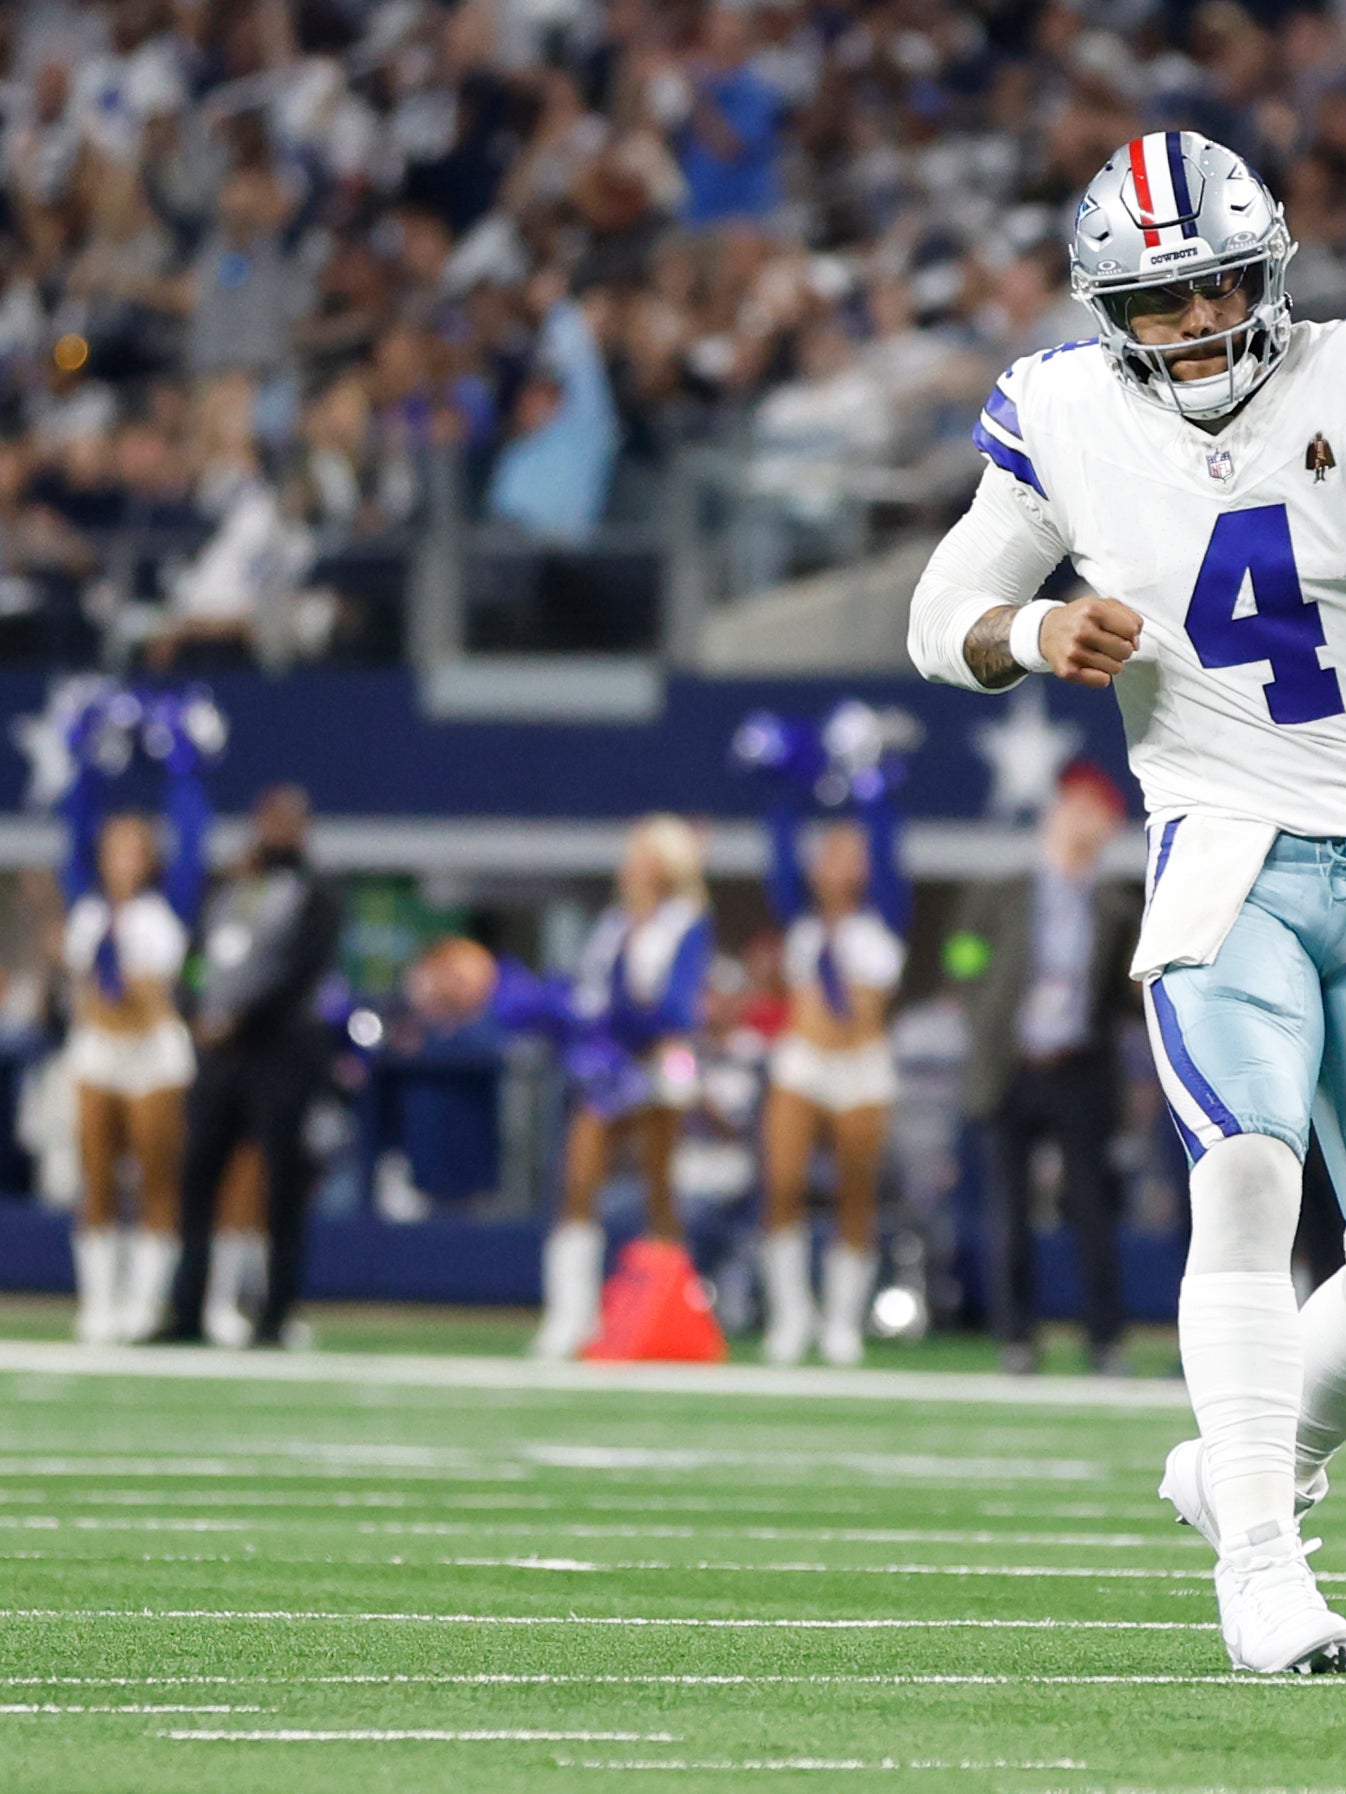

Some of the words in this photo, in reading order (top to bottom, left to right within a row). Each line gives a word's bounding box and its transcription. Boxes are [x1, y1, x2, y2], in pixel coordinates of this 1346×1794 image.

[1151, 247, 1198, 265] COWBOYS
[1211, 461, 1231, 478] NFL
[1184, 503, 1346, 725] 4
